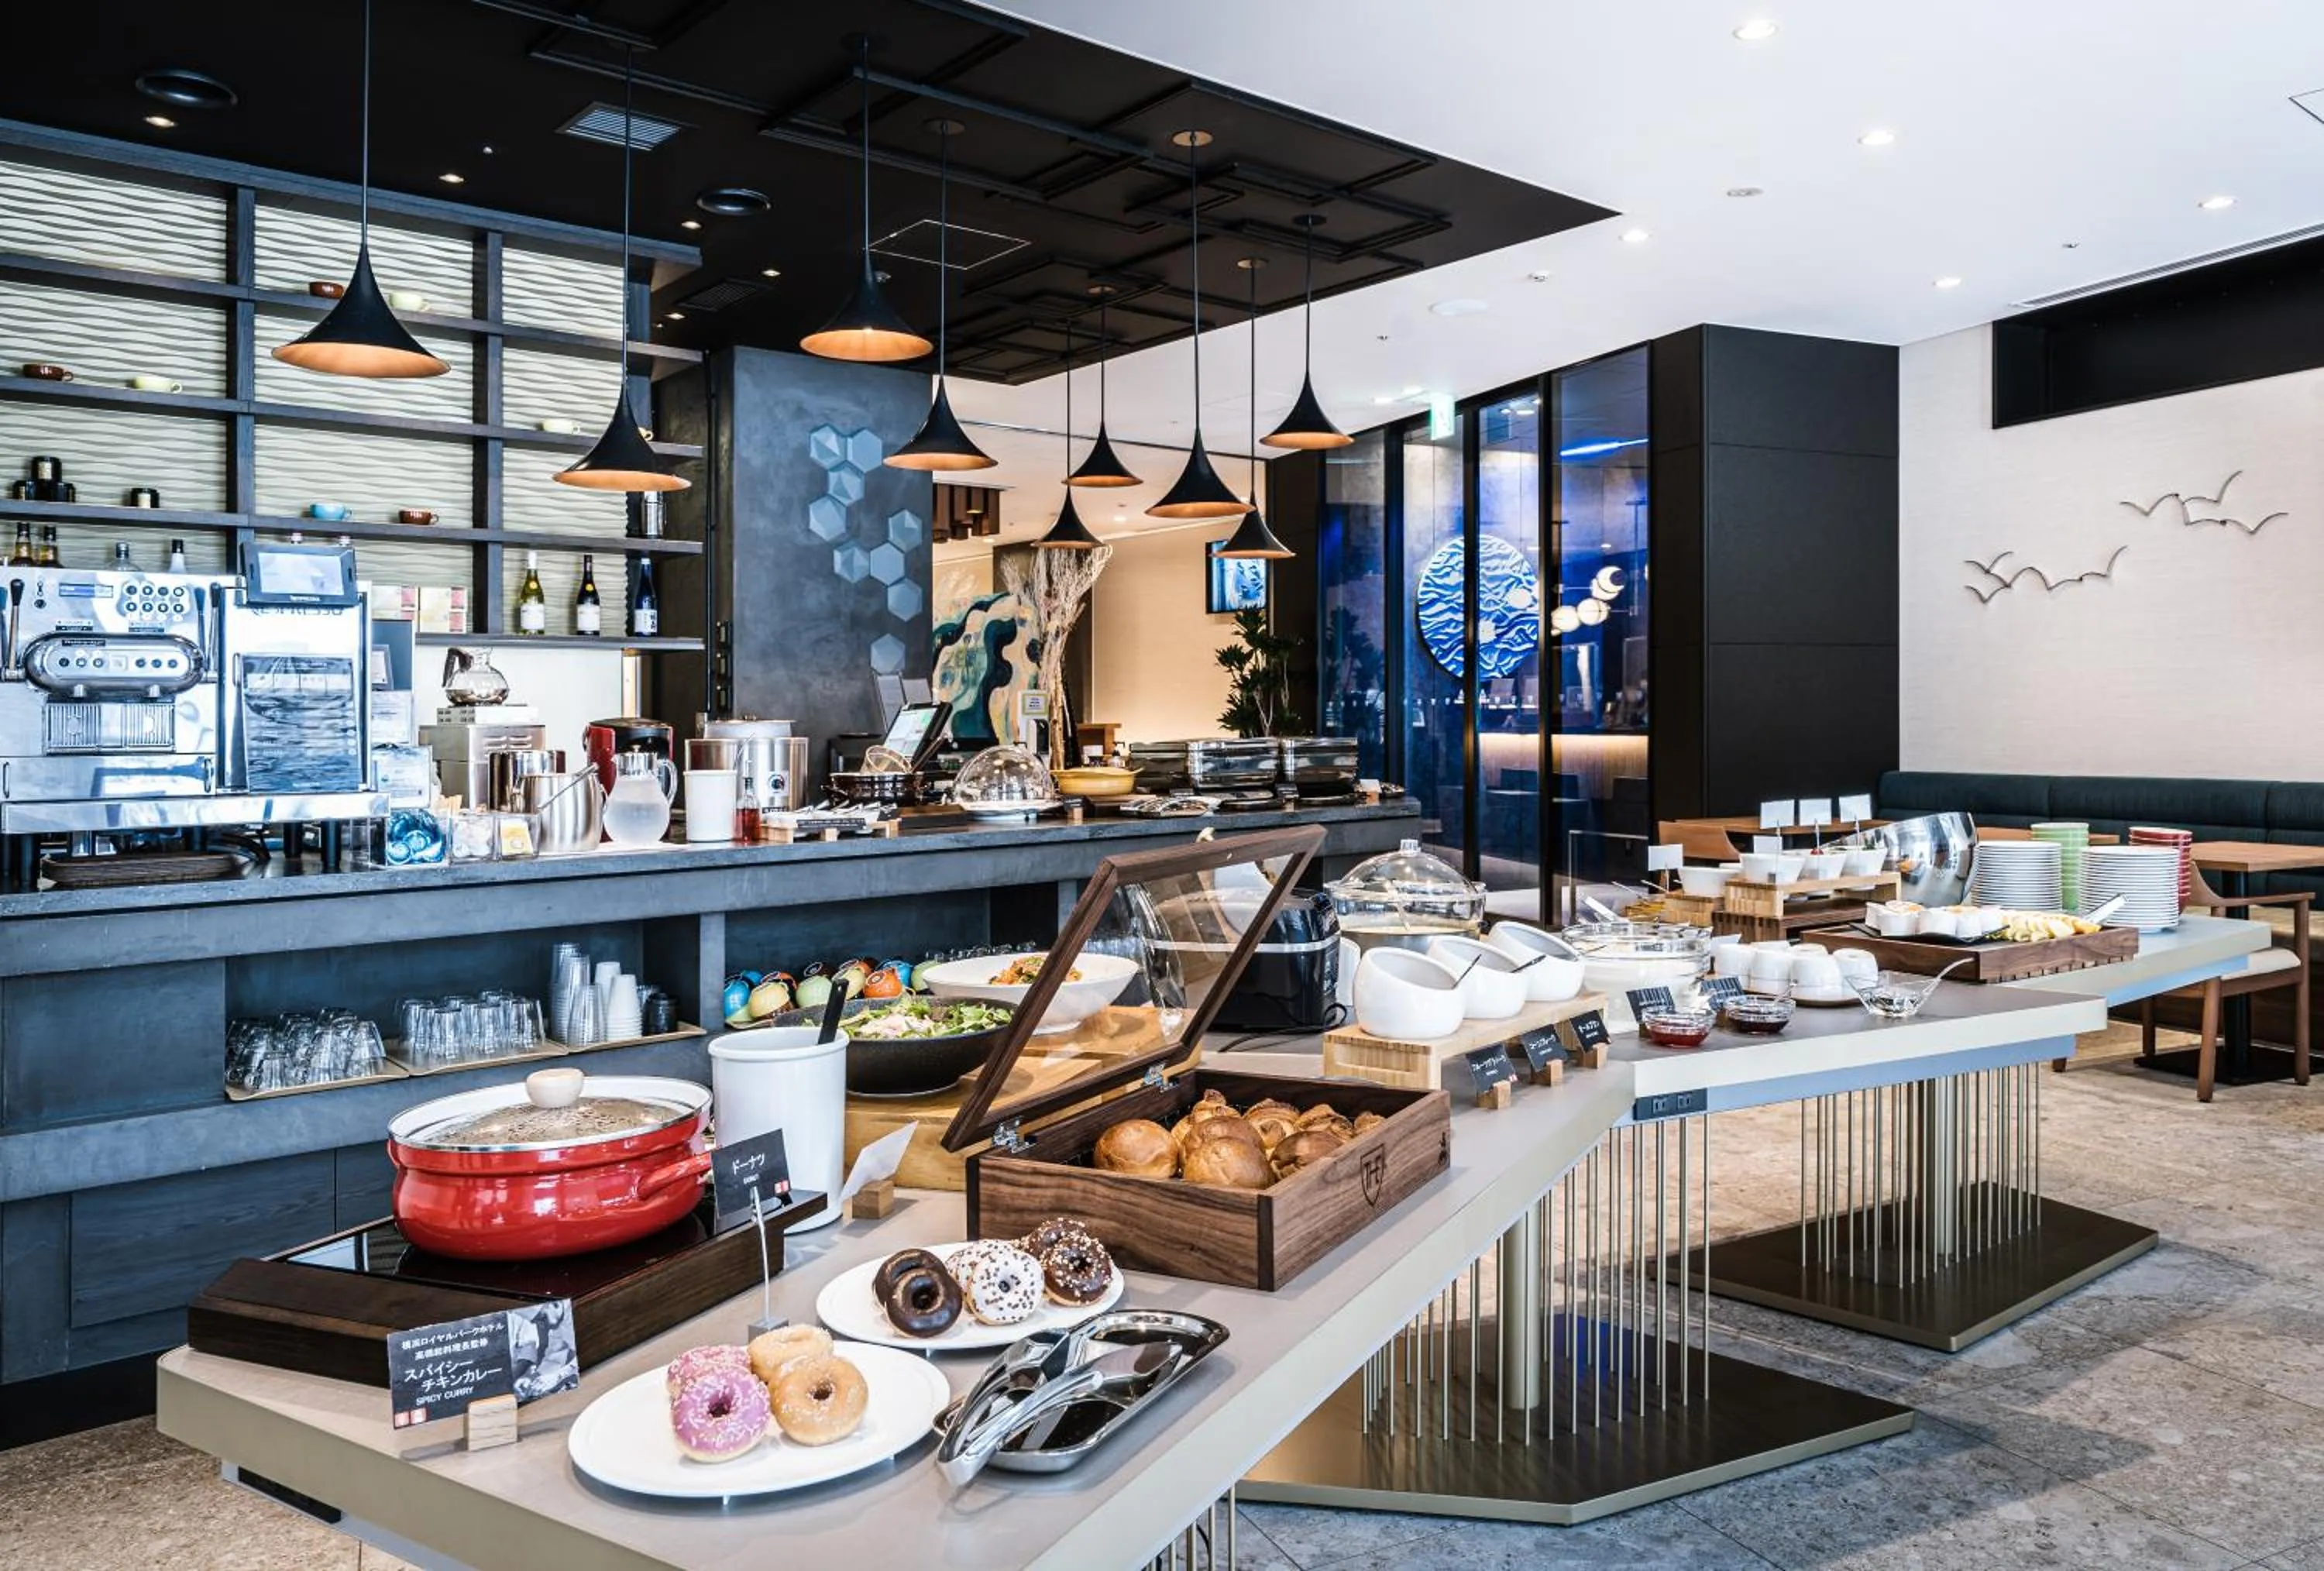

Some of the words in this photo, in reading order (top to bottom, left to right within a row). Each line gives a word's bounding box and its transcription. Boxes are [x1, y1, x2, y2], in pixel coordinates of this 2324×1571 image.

[732, 1152, 765, 1175] ドーナツ
[404, 1360, 474, 1383] スパイシー
[421, 1367, 503, 1393] チキンカレー
[416, 1394, 442, 1406] SPICY
[444, 1386, 474, 1400] CURRY
